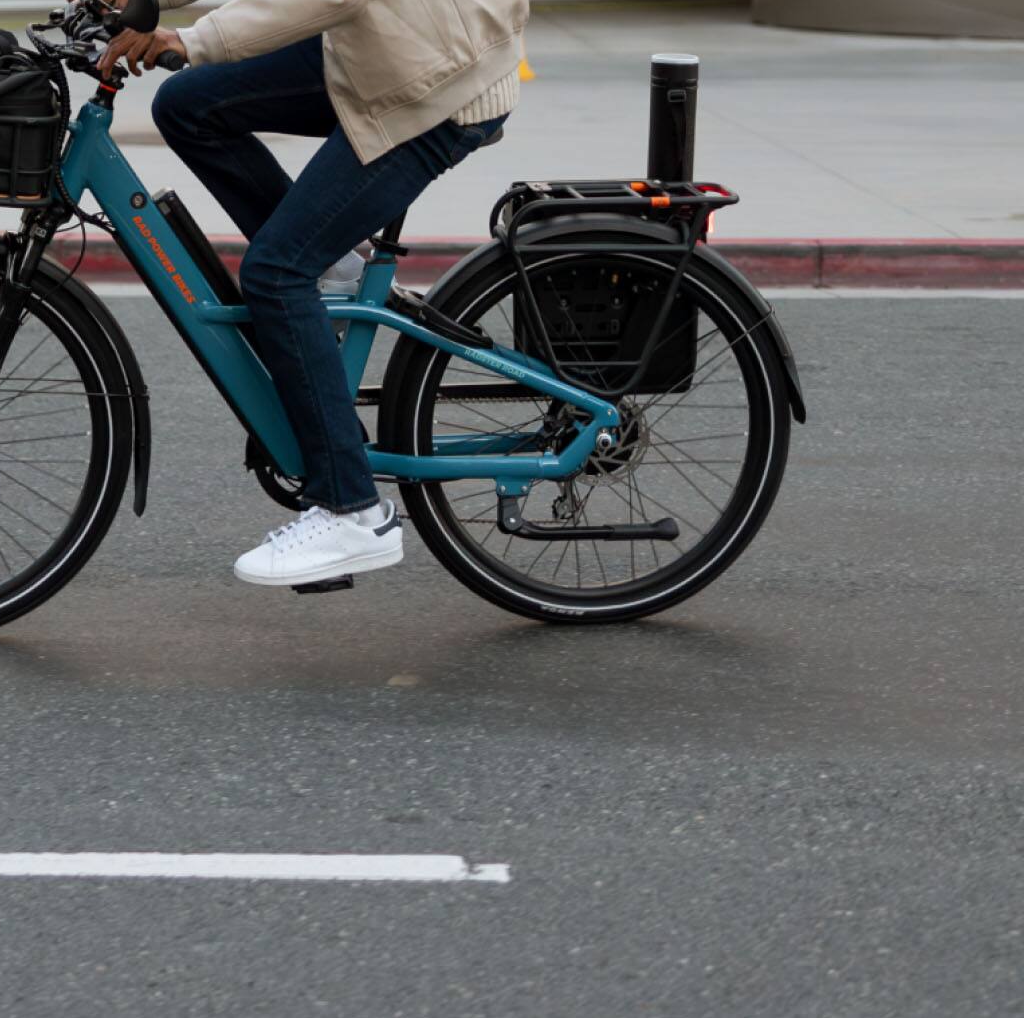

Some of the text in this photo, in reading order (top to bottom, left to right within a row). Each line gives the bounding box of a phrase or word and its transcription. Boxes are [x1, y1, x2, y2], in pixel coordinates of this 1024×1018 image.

[133, 216, 195, 303] RAD POWER BIKES
